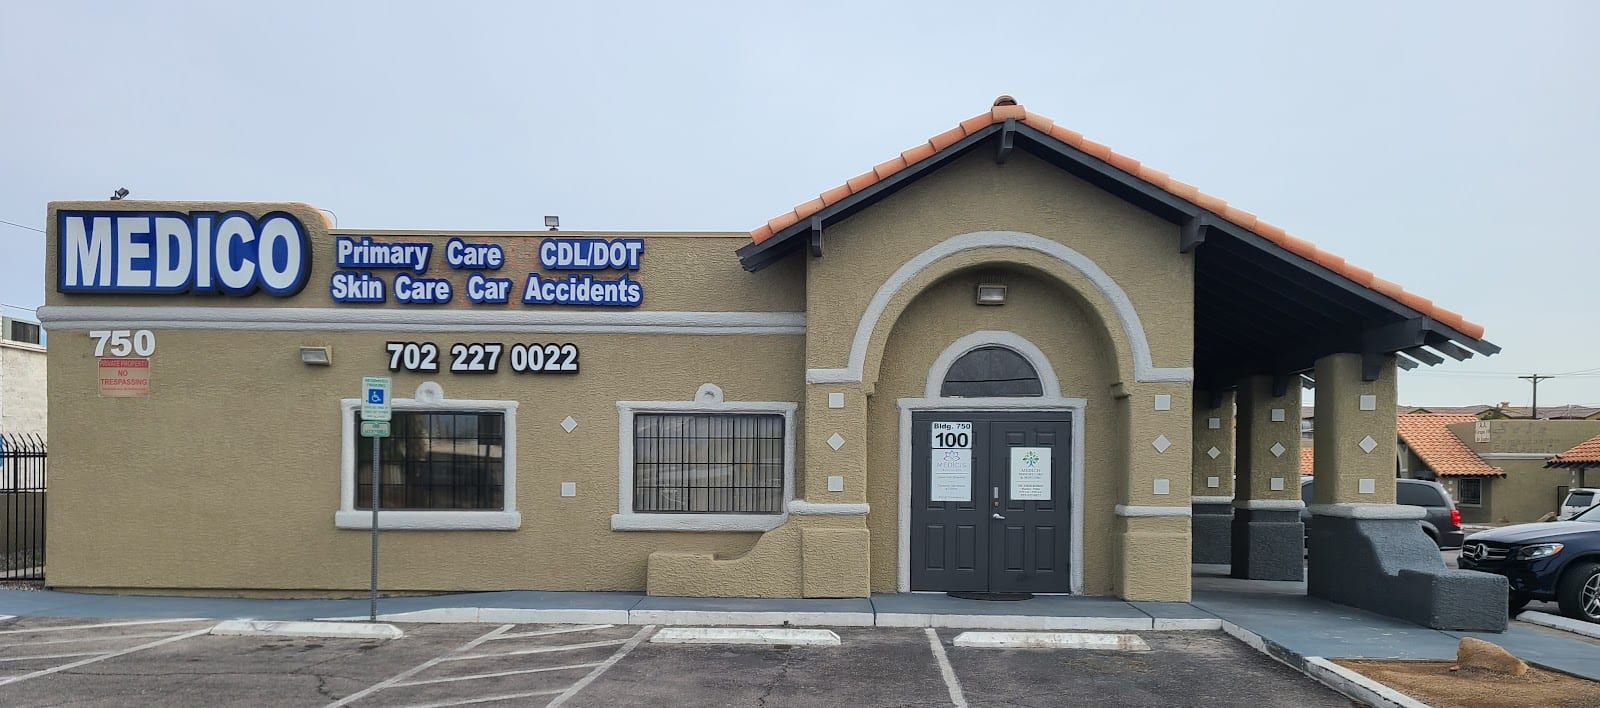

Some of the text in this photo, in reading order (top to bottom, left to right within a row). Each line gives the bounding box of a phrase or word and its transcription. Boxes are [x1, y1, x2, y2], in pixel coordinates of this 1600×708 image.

[65, 216, 301, 290] MEDICO
[338, 239, 642, 270] Primary Care CDL/DOT
[332, 274, 641, 302] Skin Care Car Accidents
[89, 329, 156, 357] 750
[387, 343, 578, 371] 702 227 0022
[117, 369, 129, 377] NO
[933, 423, 954, 431] Bldg.
[935, 432, 969, 448] 100
